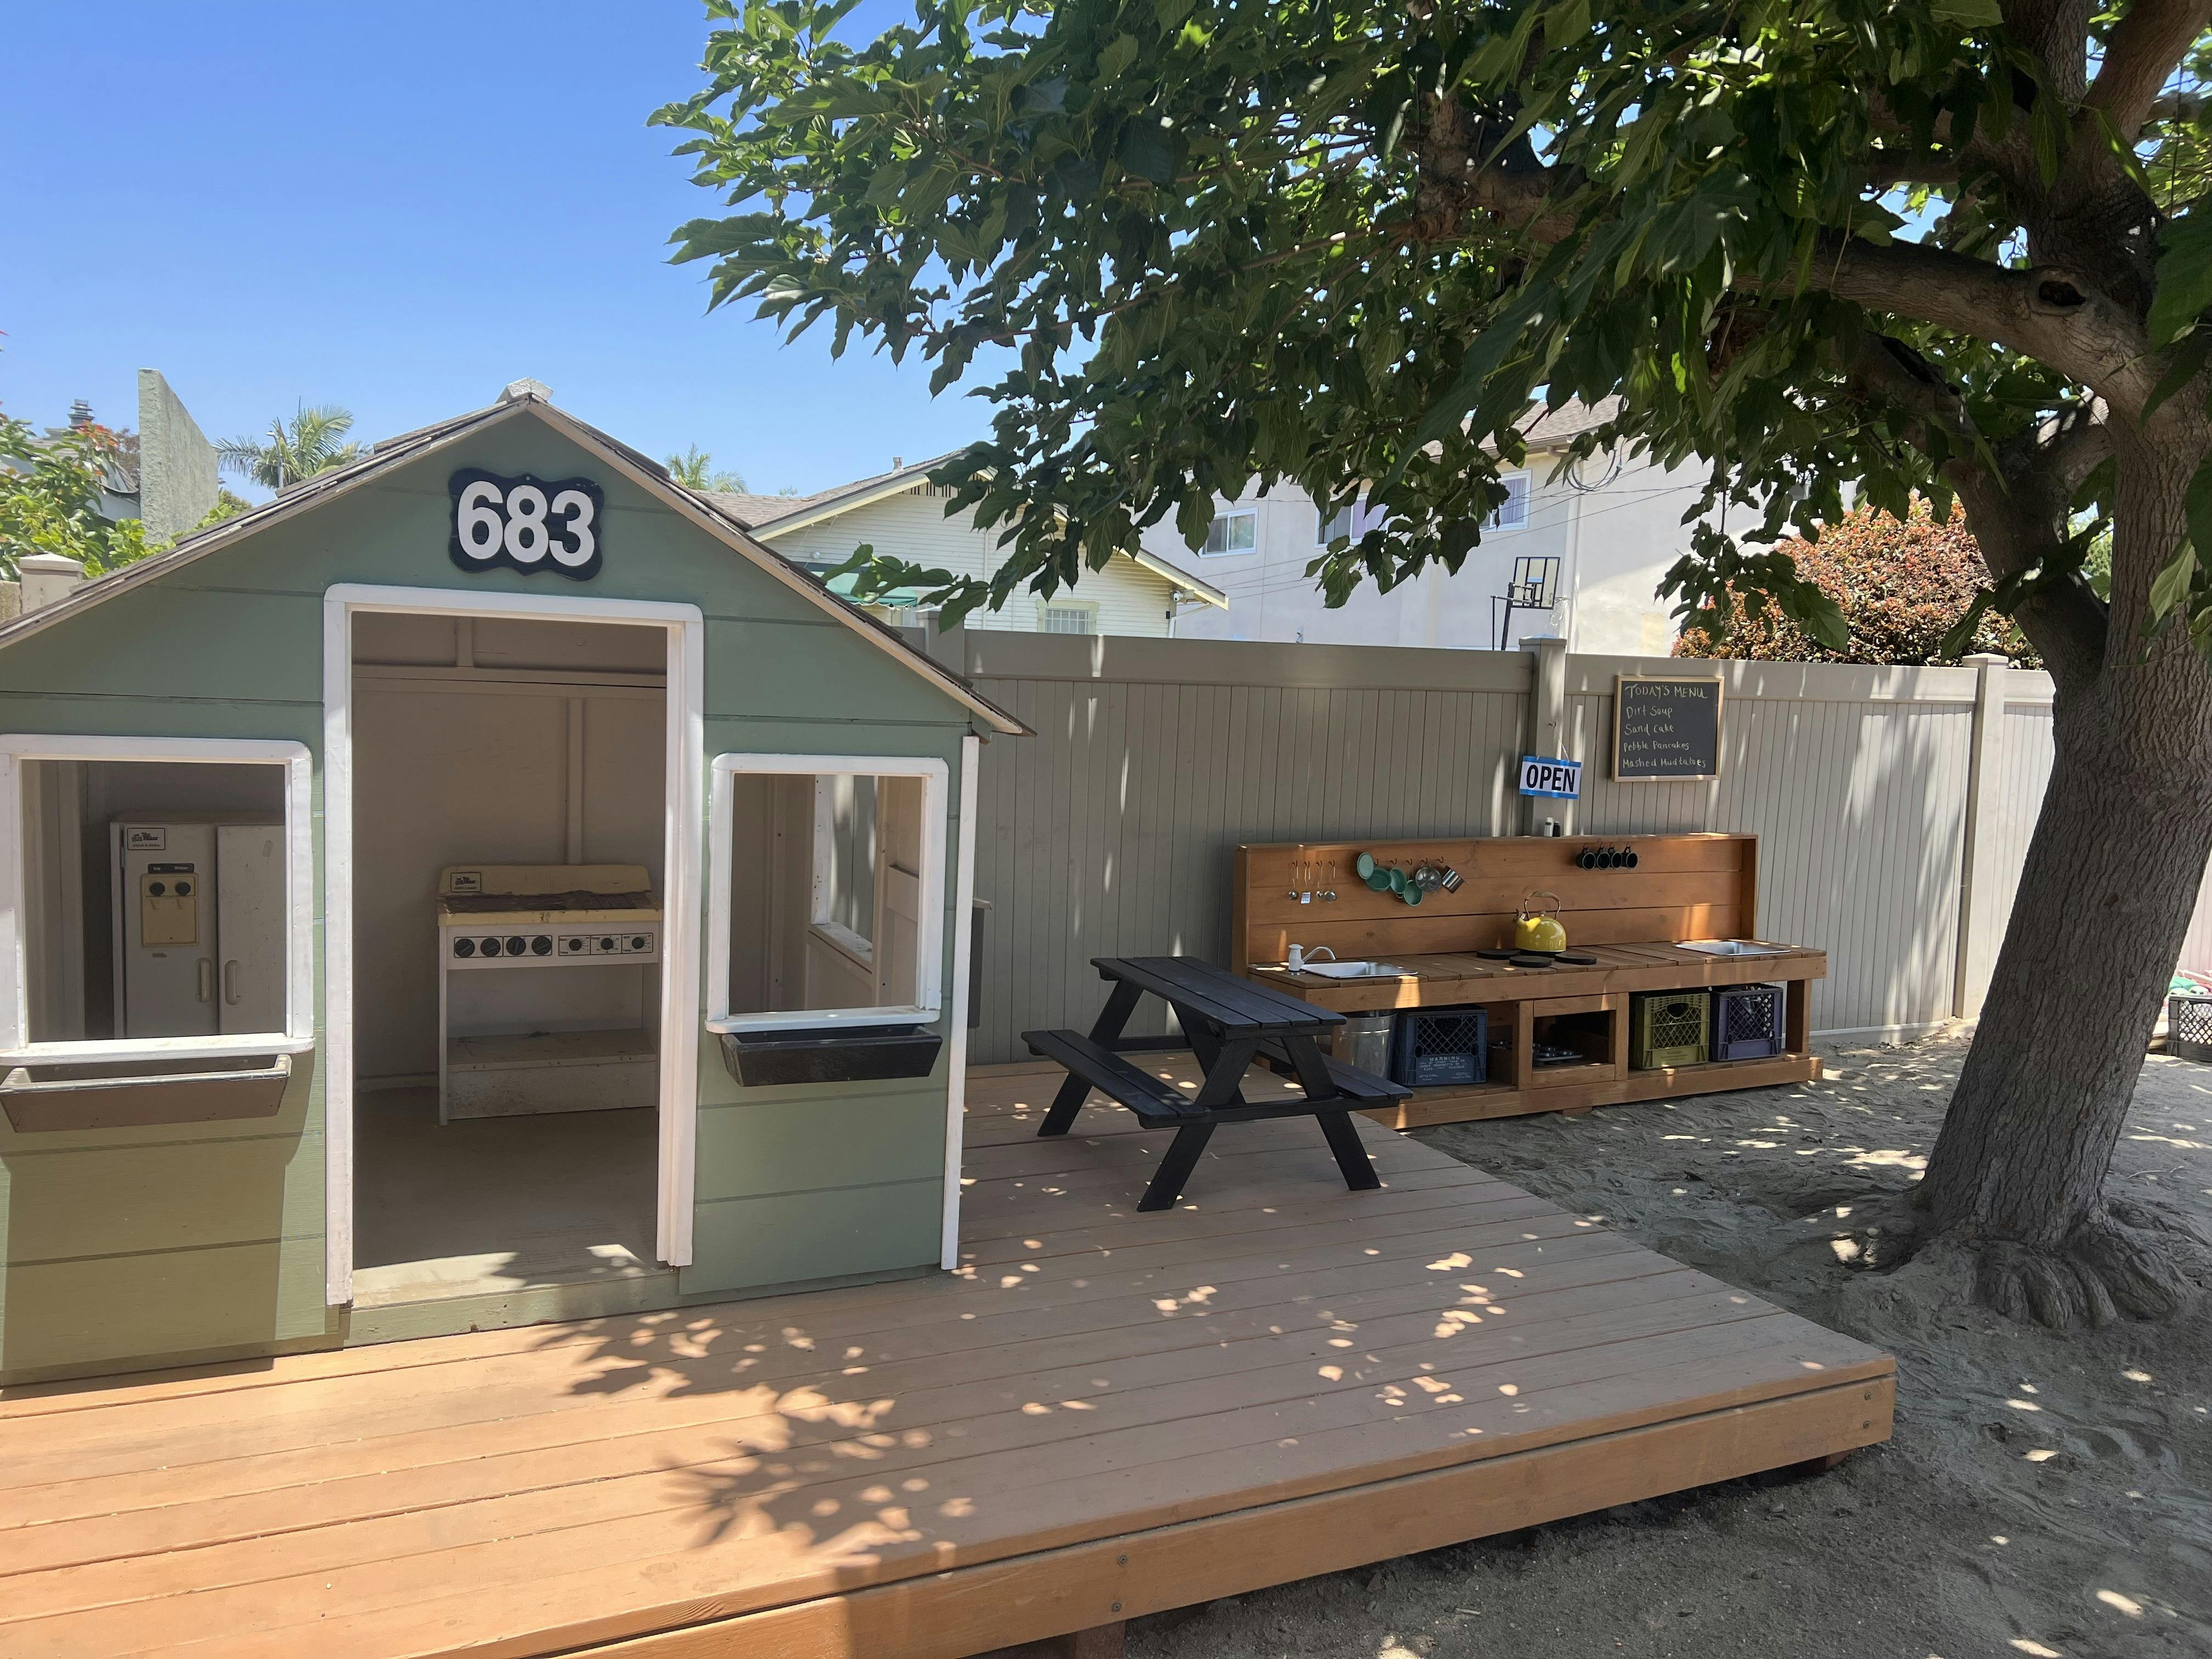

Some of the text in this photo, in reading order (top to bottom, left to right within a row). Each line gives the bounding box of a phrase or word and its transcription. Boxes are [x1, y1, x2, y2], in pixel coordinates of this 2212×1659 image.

[458, 481, 595, 566] 683
[1624, 683, 1708, 700] TODAY'S MENU
[1626, 704, 1673, 719] Dirt Soup
[1624, 723, 1651, 736] Sand
[1652, 741, 1690, 751] Pancakes
[1623, 757, 1706, 769] Mashed Mudtatoes
[1526, 764, 1576, 792] OPEN
